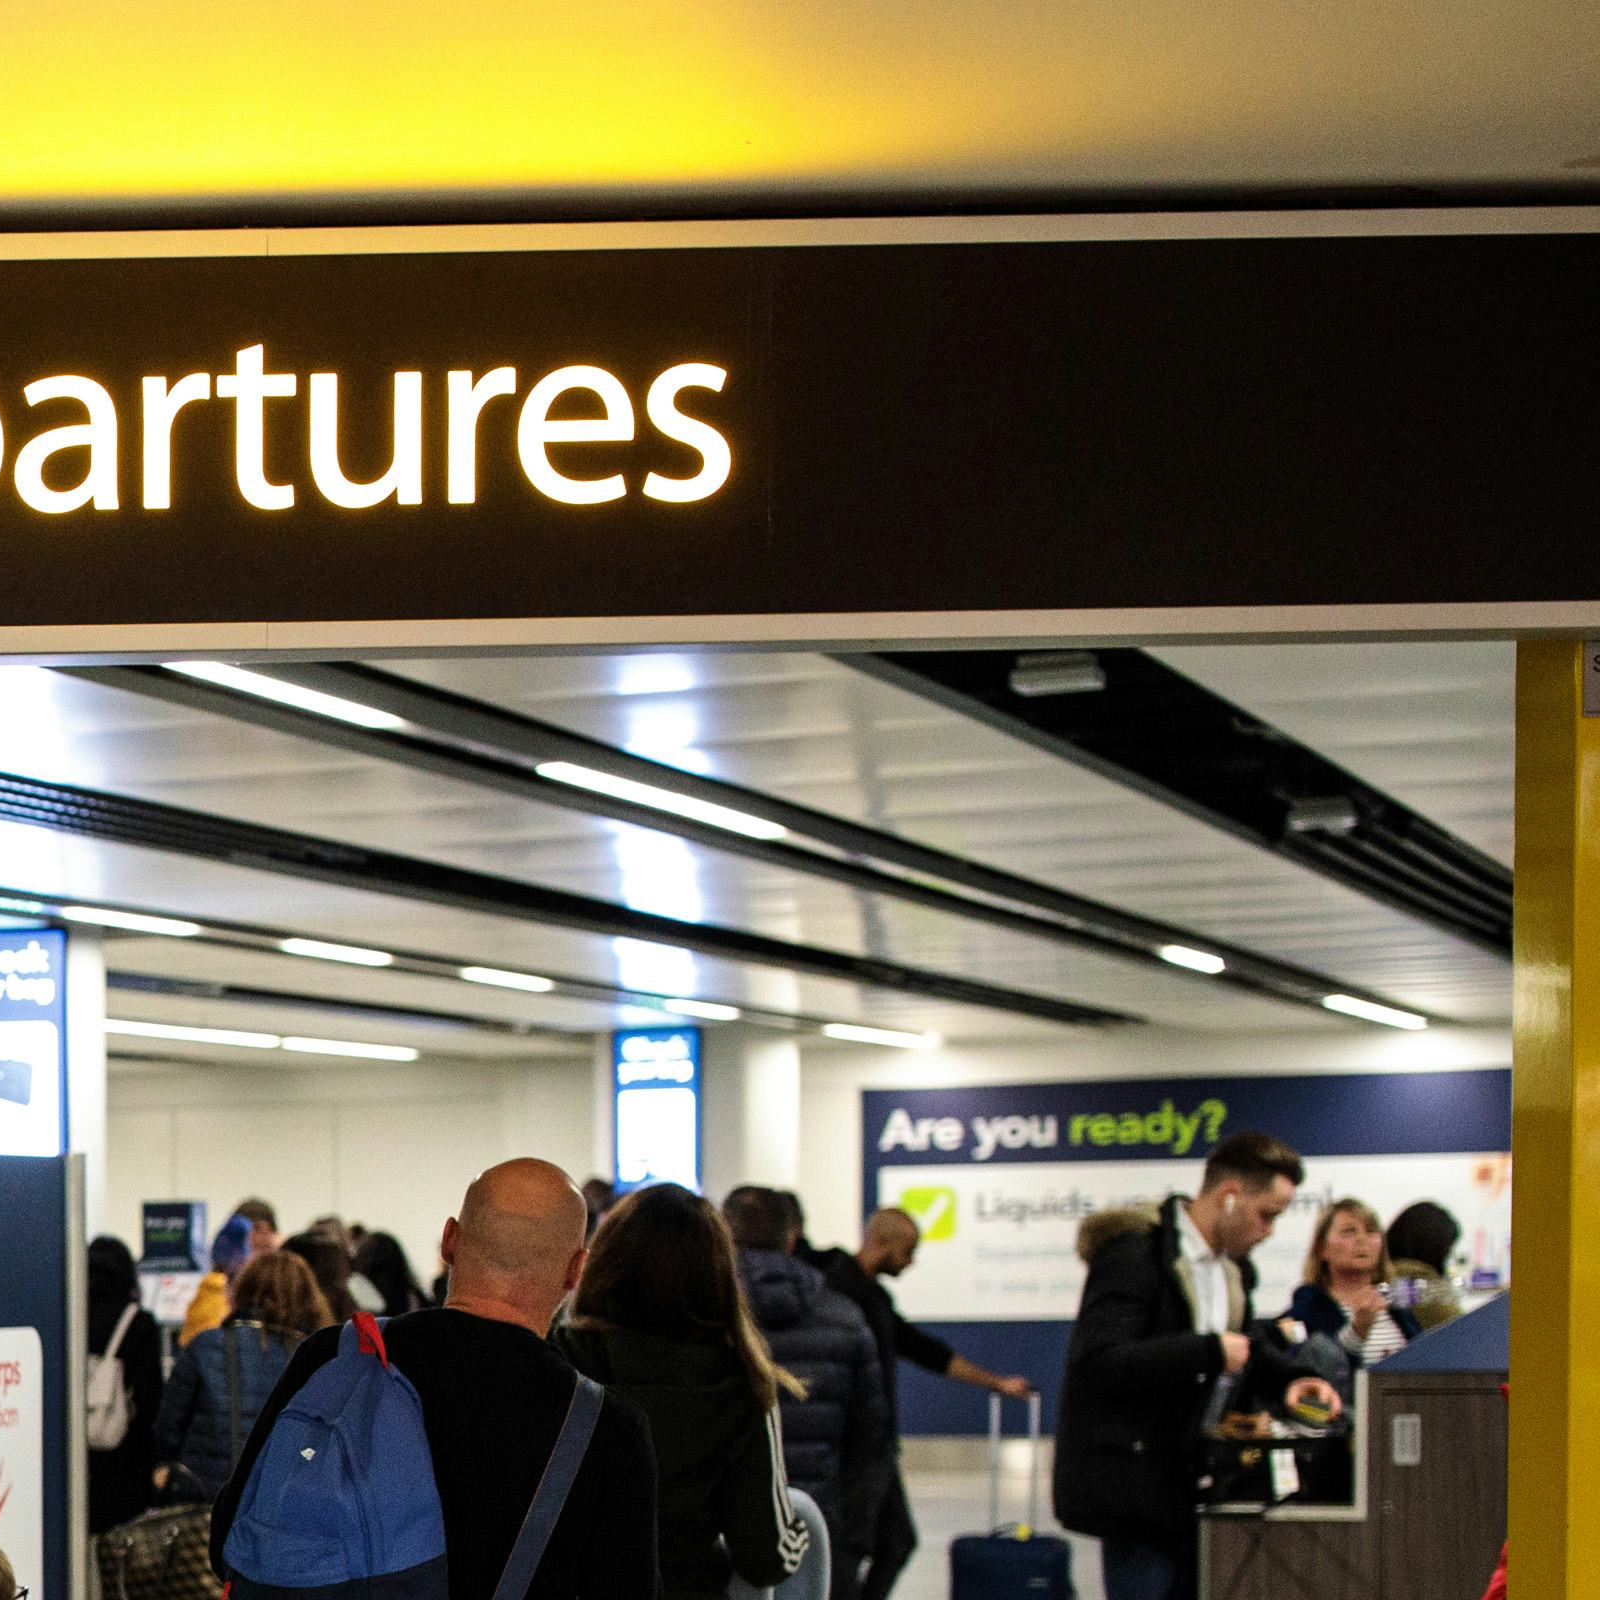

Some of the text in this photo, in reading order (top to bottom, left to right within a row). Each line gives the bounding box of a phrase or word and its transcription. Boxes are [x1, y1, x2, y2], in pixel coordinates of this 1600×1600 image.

[878, 1098, 1227, 1162] Are you ready?
